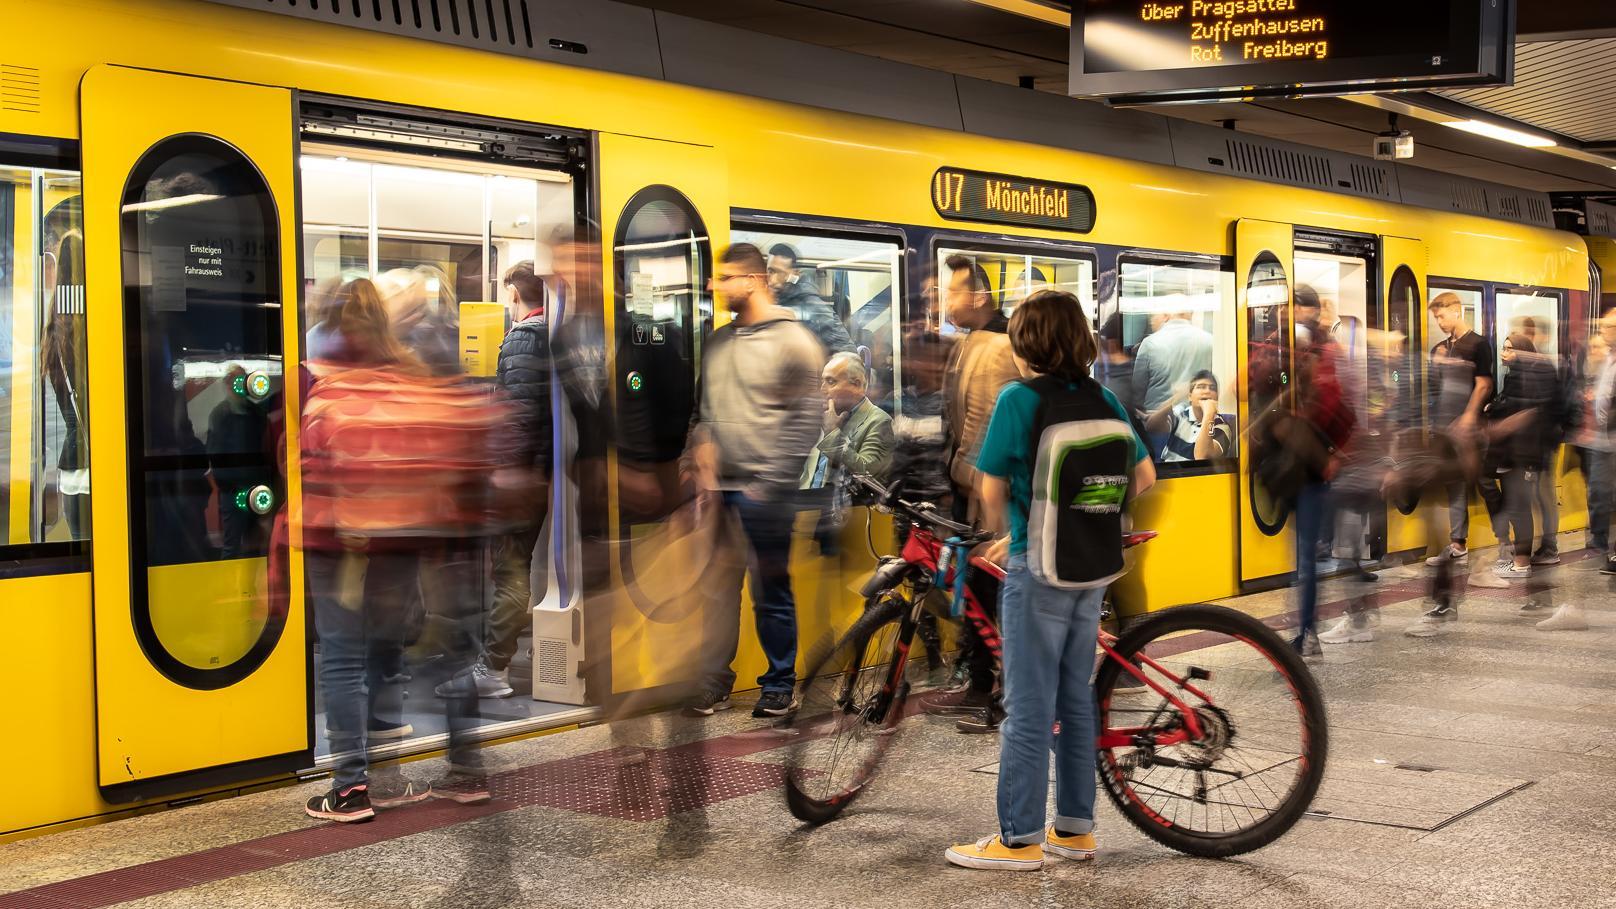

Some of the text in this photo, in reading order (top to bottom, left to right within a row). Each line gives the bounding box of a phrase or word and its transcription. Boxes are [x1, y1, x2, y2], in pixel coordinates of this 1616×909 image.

[1141, 4, 1184, 21] über
[1191, 17, 1325, 42] Zuffenhausen
[1191, 40, 1328, 62] Rot Freiberg
[935, 171, 1069, 218] U7 Mönchfeld
[190, 244, 222, 256] Einsteigen
[198, 256, 222, 266] nur mit
[184, 265, 223, 277] Fahrausweis
